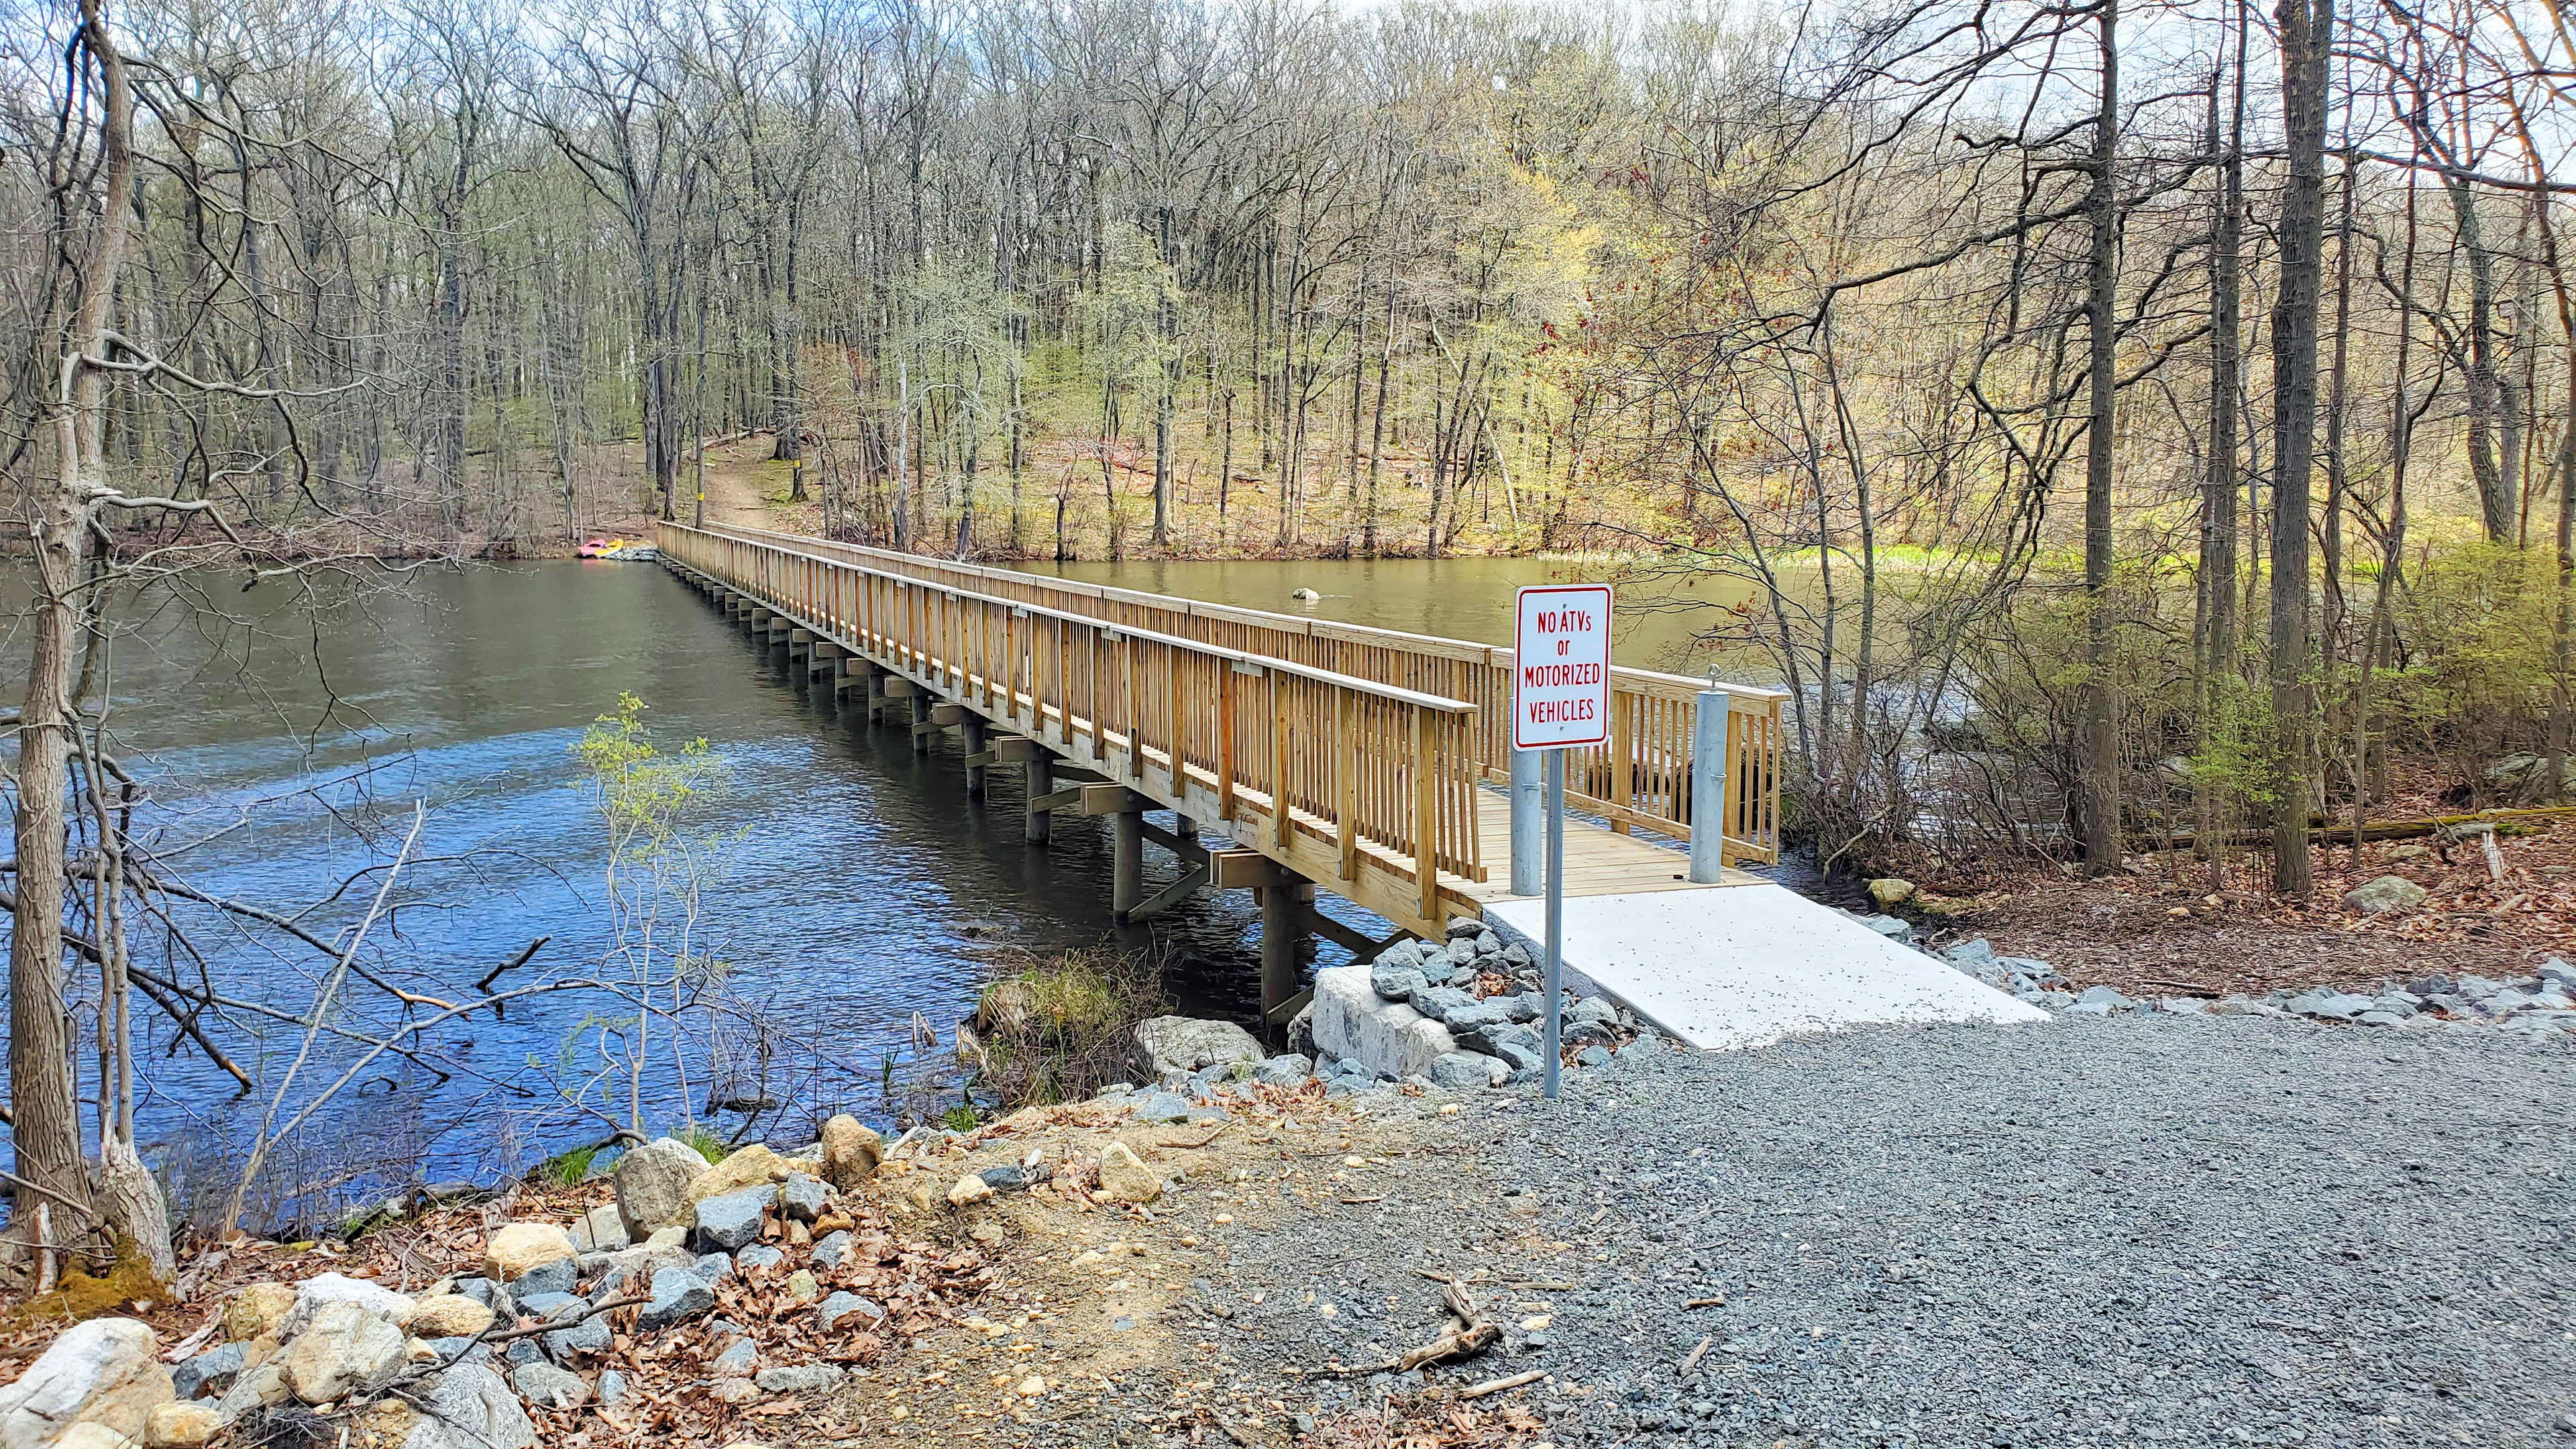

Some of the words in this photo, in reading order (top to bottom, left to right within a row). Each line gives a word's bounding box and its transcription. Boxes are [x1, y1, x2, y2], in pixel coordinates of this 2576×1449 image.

[1538, 611, 1556, 633] NO
[1560, 610, 1591, 632] ATVs
[1557, 639, 1570, 656] or
[1525, 663, 1600, 688] MOTORIZED
[1529, 698, 1593, 723] VEHICLES
